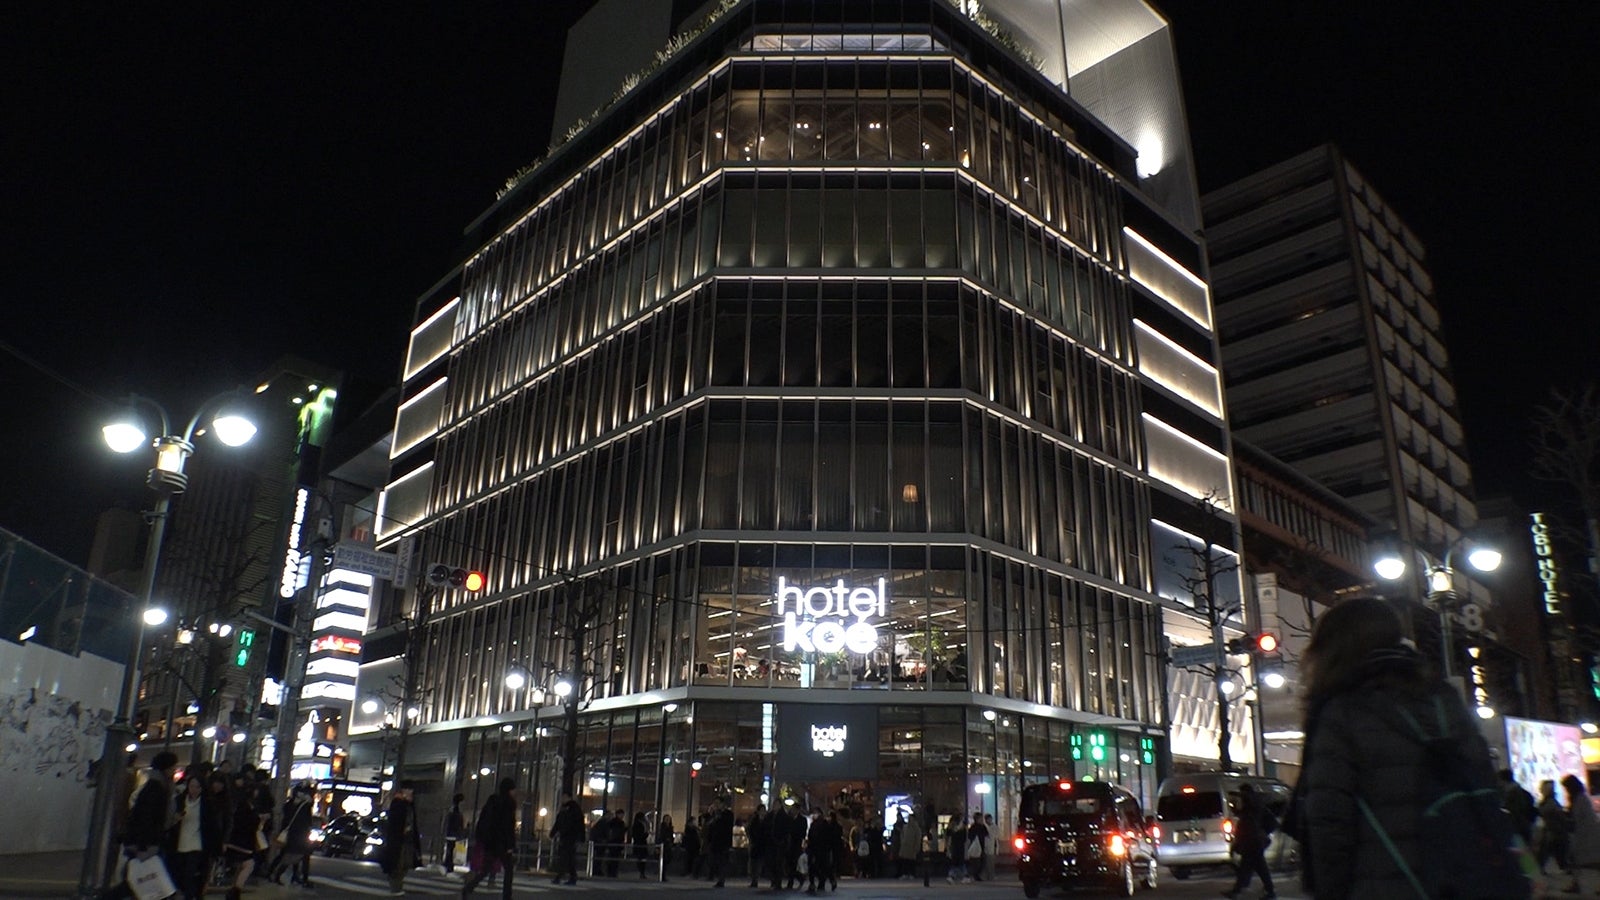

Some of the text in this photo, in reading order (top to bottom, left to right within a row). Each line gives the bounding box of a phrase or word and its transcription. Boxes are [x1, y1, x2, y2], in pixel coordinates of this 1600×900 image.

[1529, 512, 1562, 615] TOBU HOTEL
[777, 575, 885, 617] hotel
[811, 724, 848, 741] hotel
